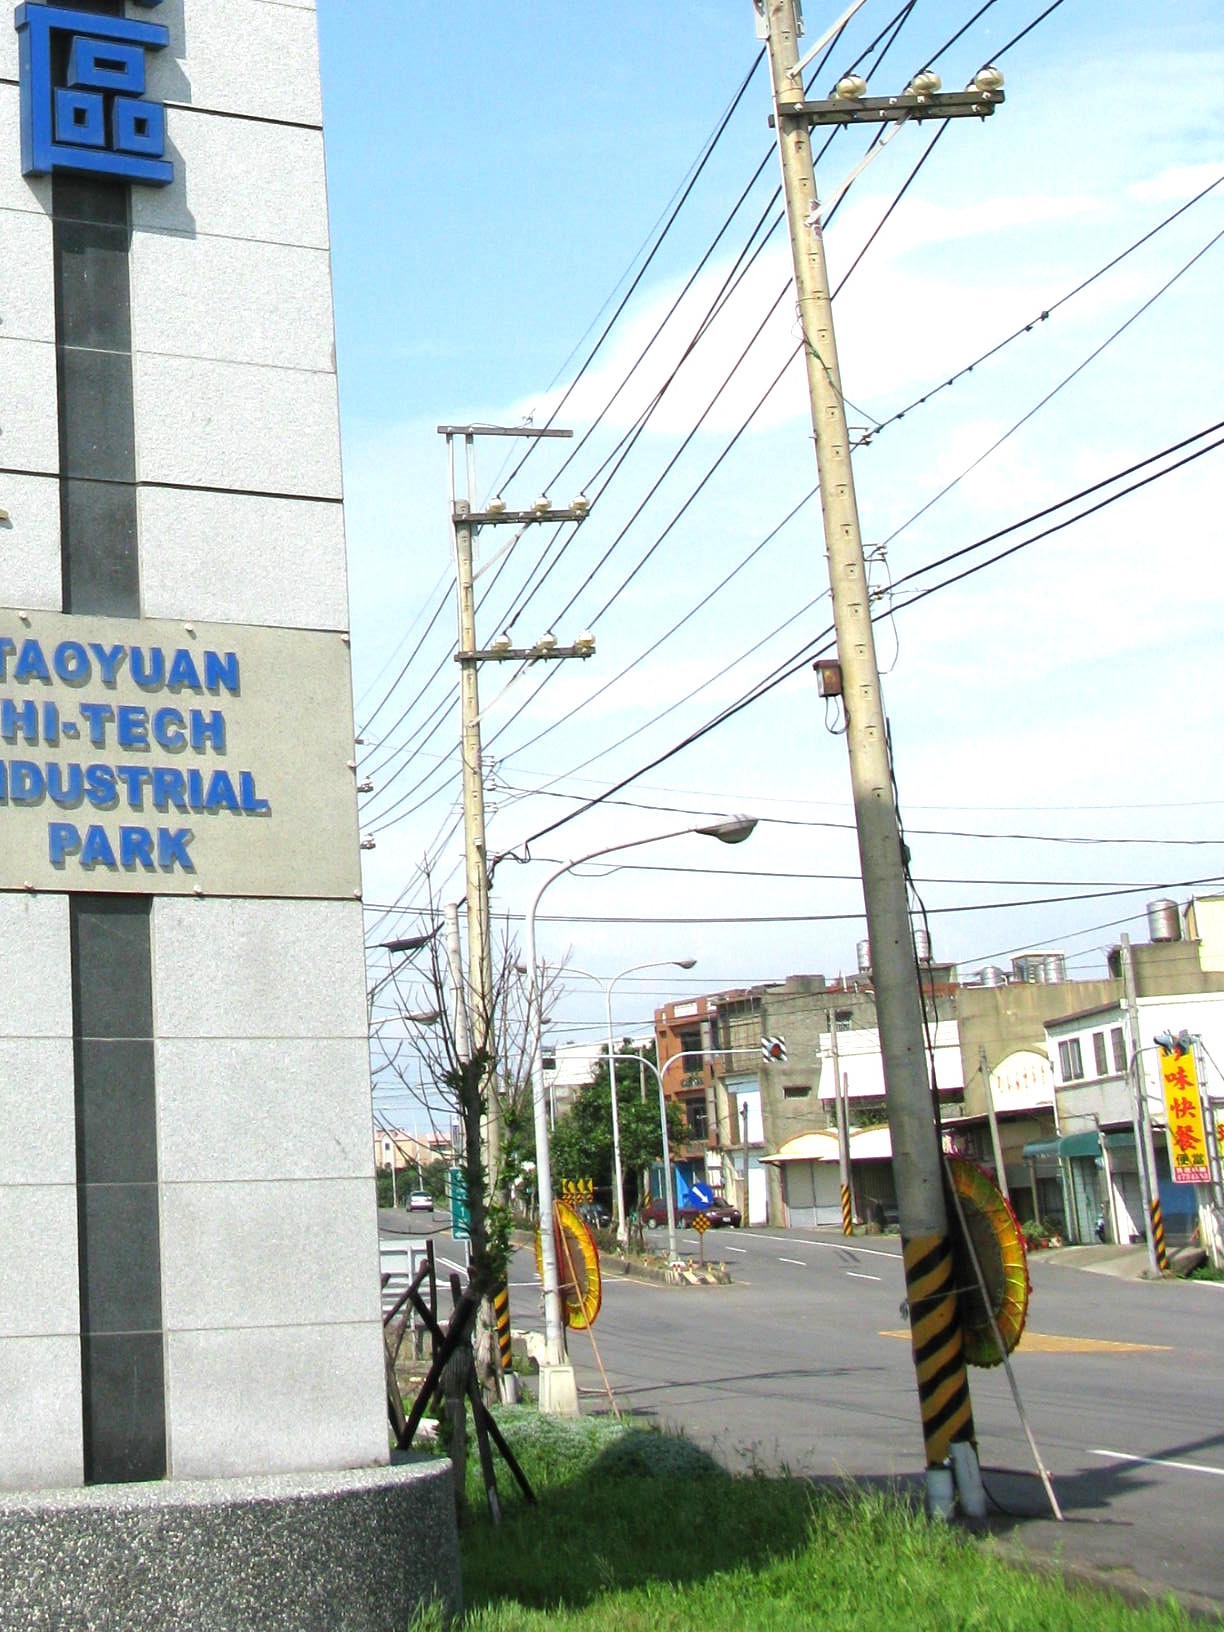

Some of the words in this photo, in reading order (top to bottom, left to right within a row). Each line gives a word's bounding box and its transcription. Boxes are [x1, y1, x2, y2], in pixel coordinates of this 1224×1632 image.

[0, 698, 225, 751] HI-TECH
[48, 822, 196, 869] PARK
[1164, 1047, 1201, 1153] 味快餐
